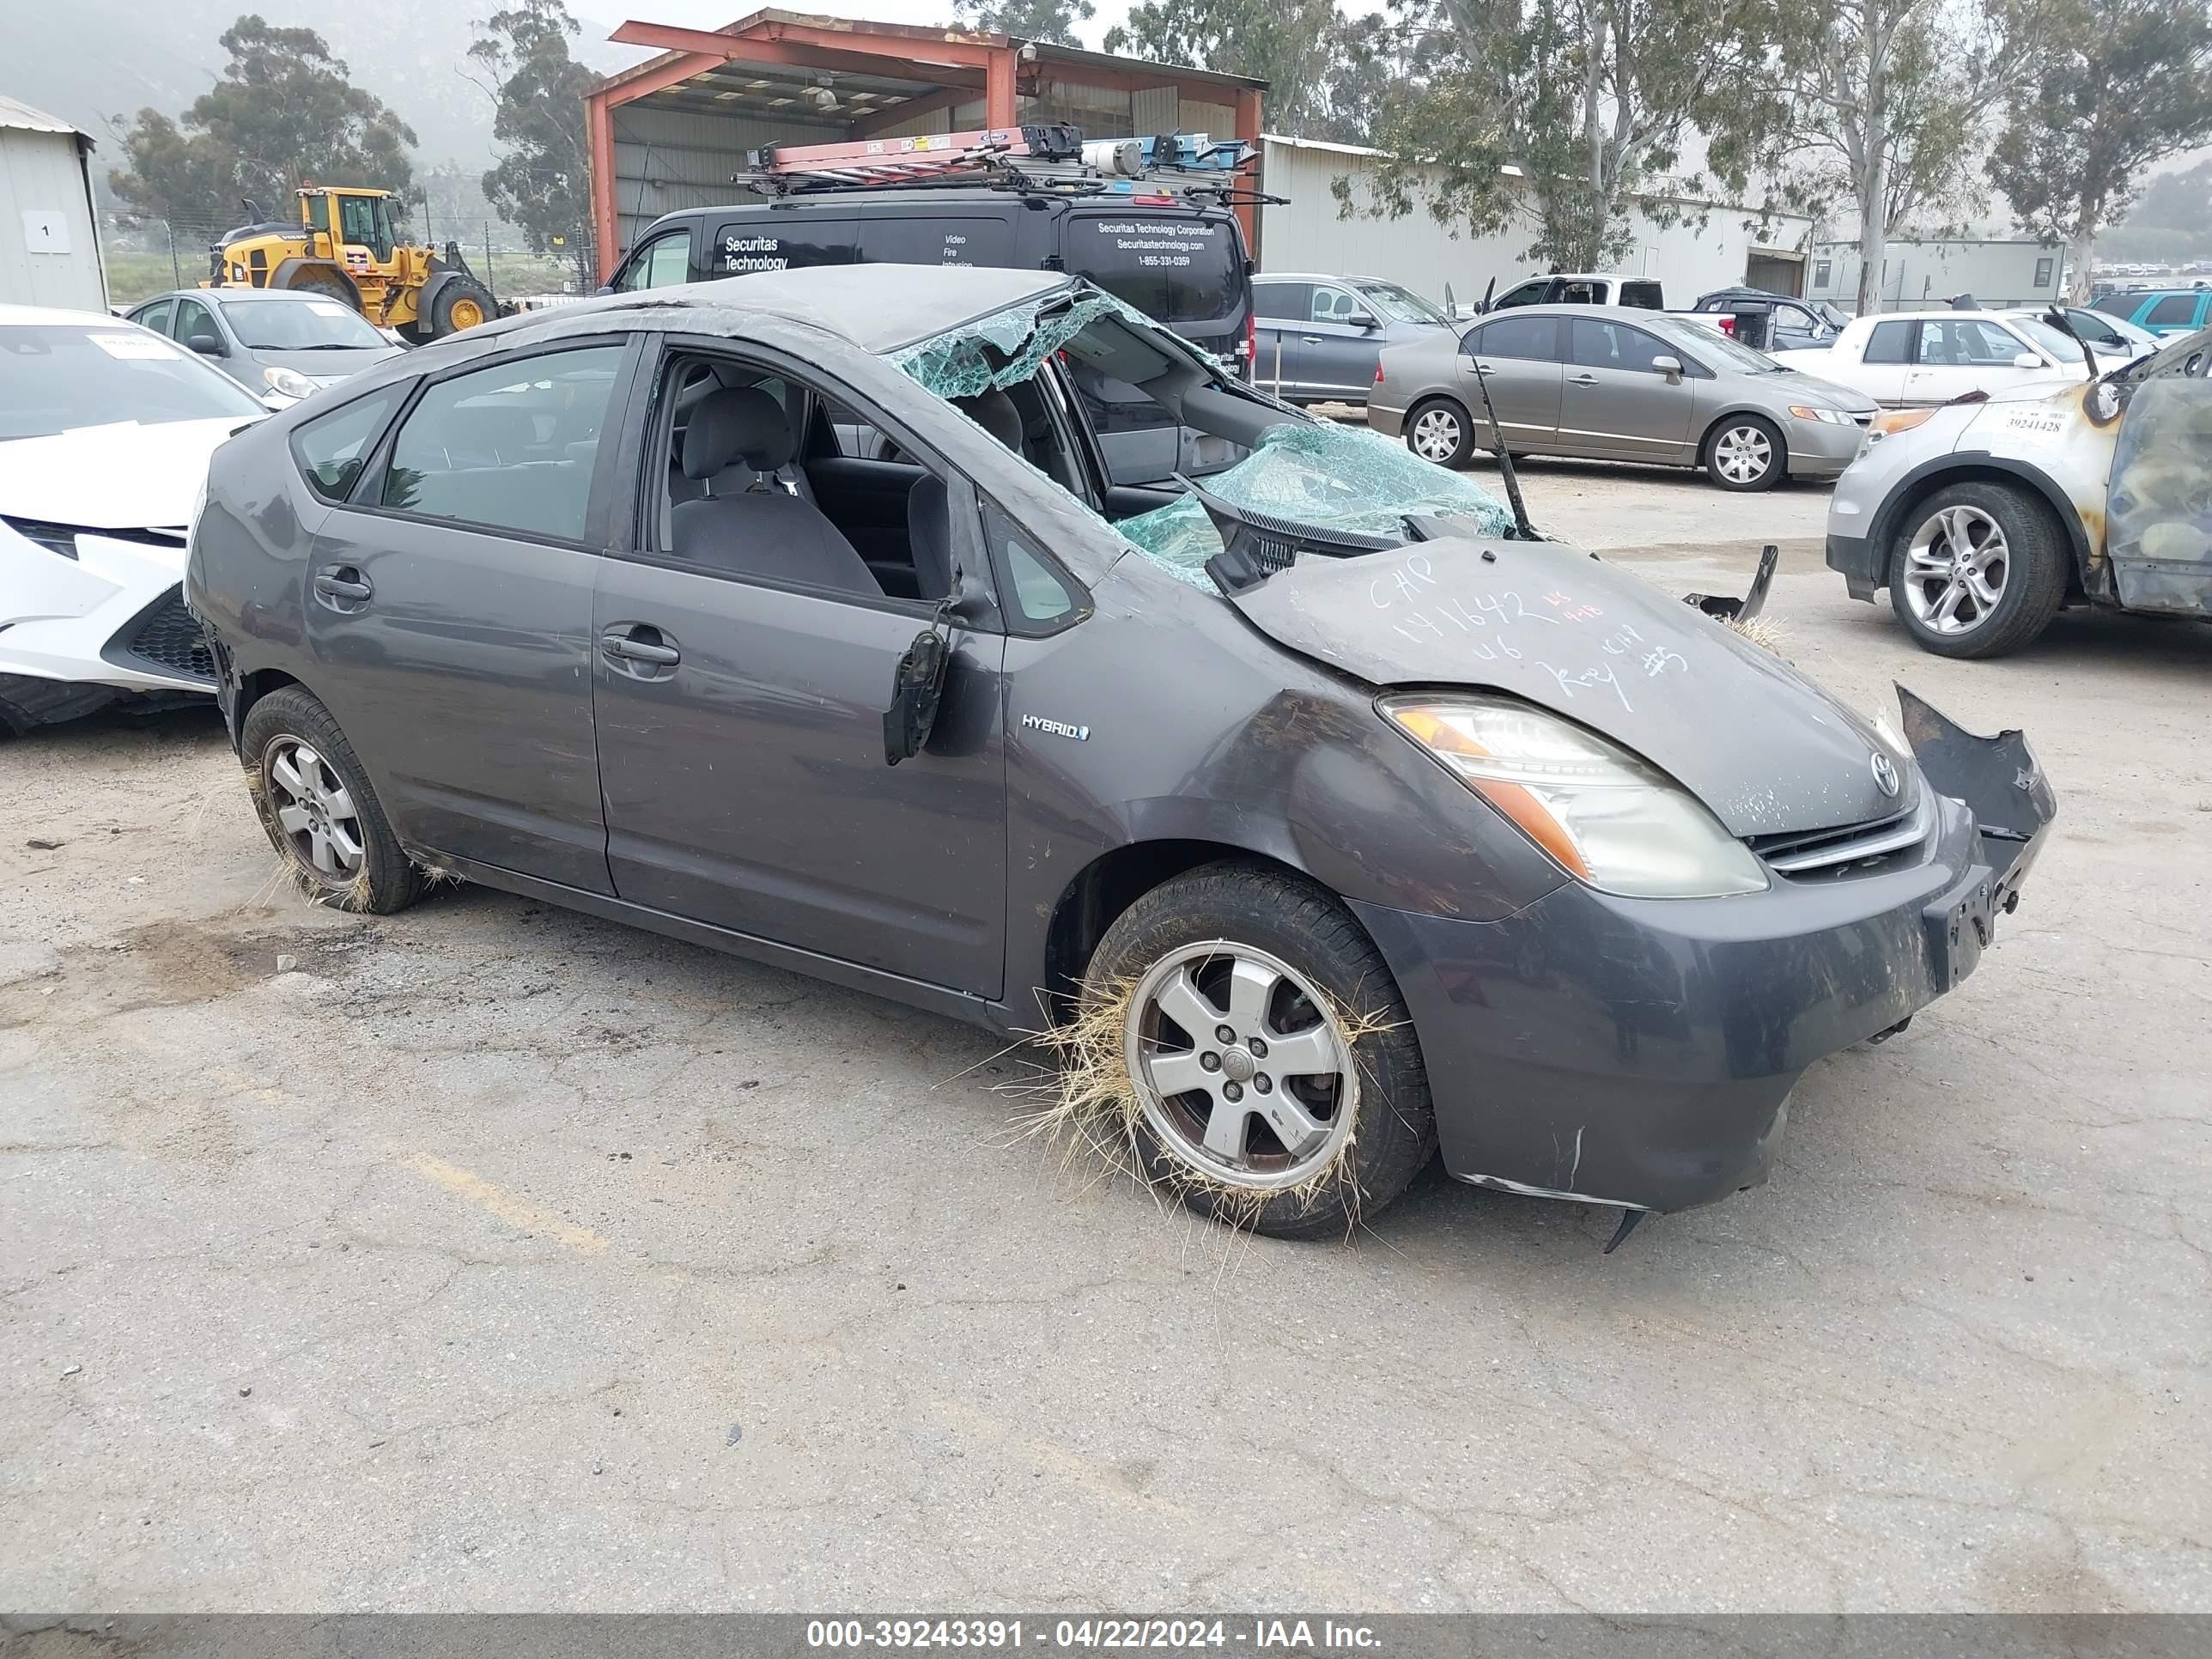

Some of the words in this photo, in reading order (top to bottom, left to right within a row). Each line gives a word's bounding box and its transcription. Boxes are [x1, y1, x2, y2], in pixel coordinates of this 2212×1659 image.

[42, 225, 49, 236] 1
[1098, 222, 1135, 234] Securitas
[1135, 223, 1176, 236] Technology
[1176, 225, 1215, 237] Corporation
[725, 235, 778, 252] Securitas
[945, 234, 966, 244] Video
[1117, 239, 1205, 252] Securitastechnology.com
[944, 247, 957, 257] Fire
[725, 255, 788, 270] Technology
[1139, 256, 1190, 265] 1-855-331-0359
[2006, 418, 2062, 433] 39241428
[1393, 591, 1560, 643] 141642
[1022, 714, 1079, 738] HYBRID
